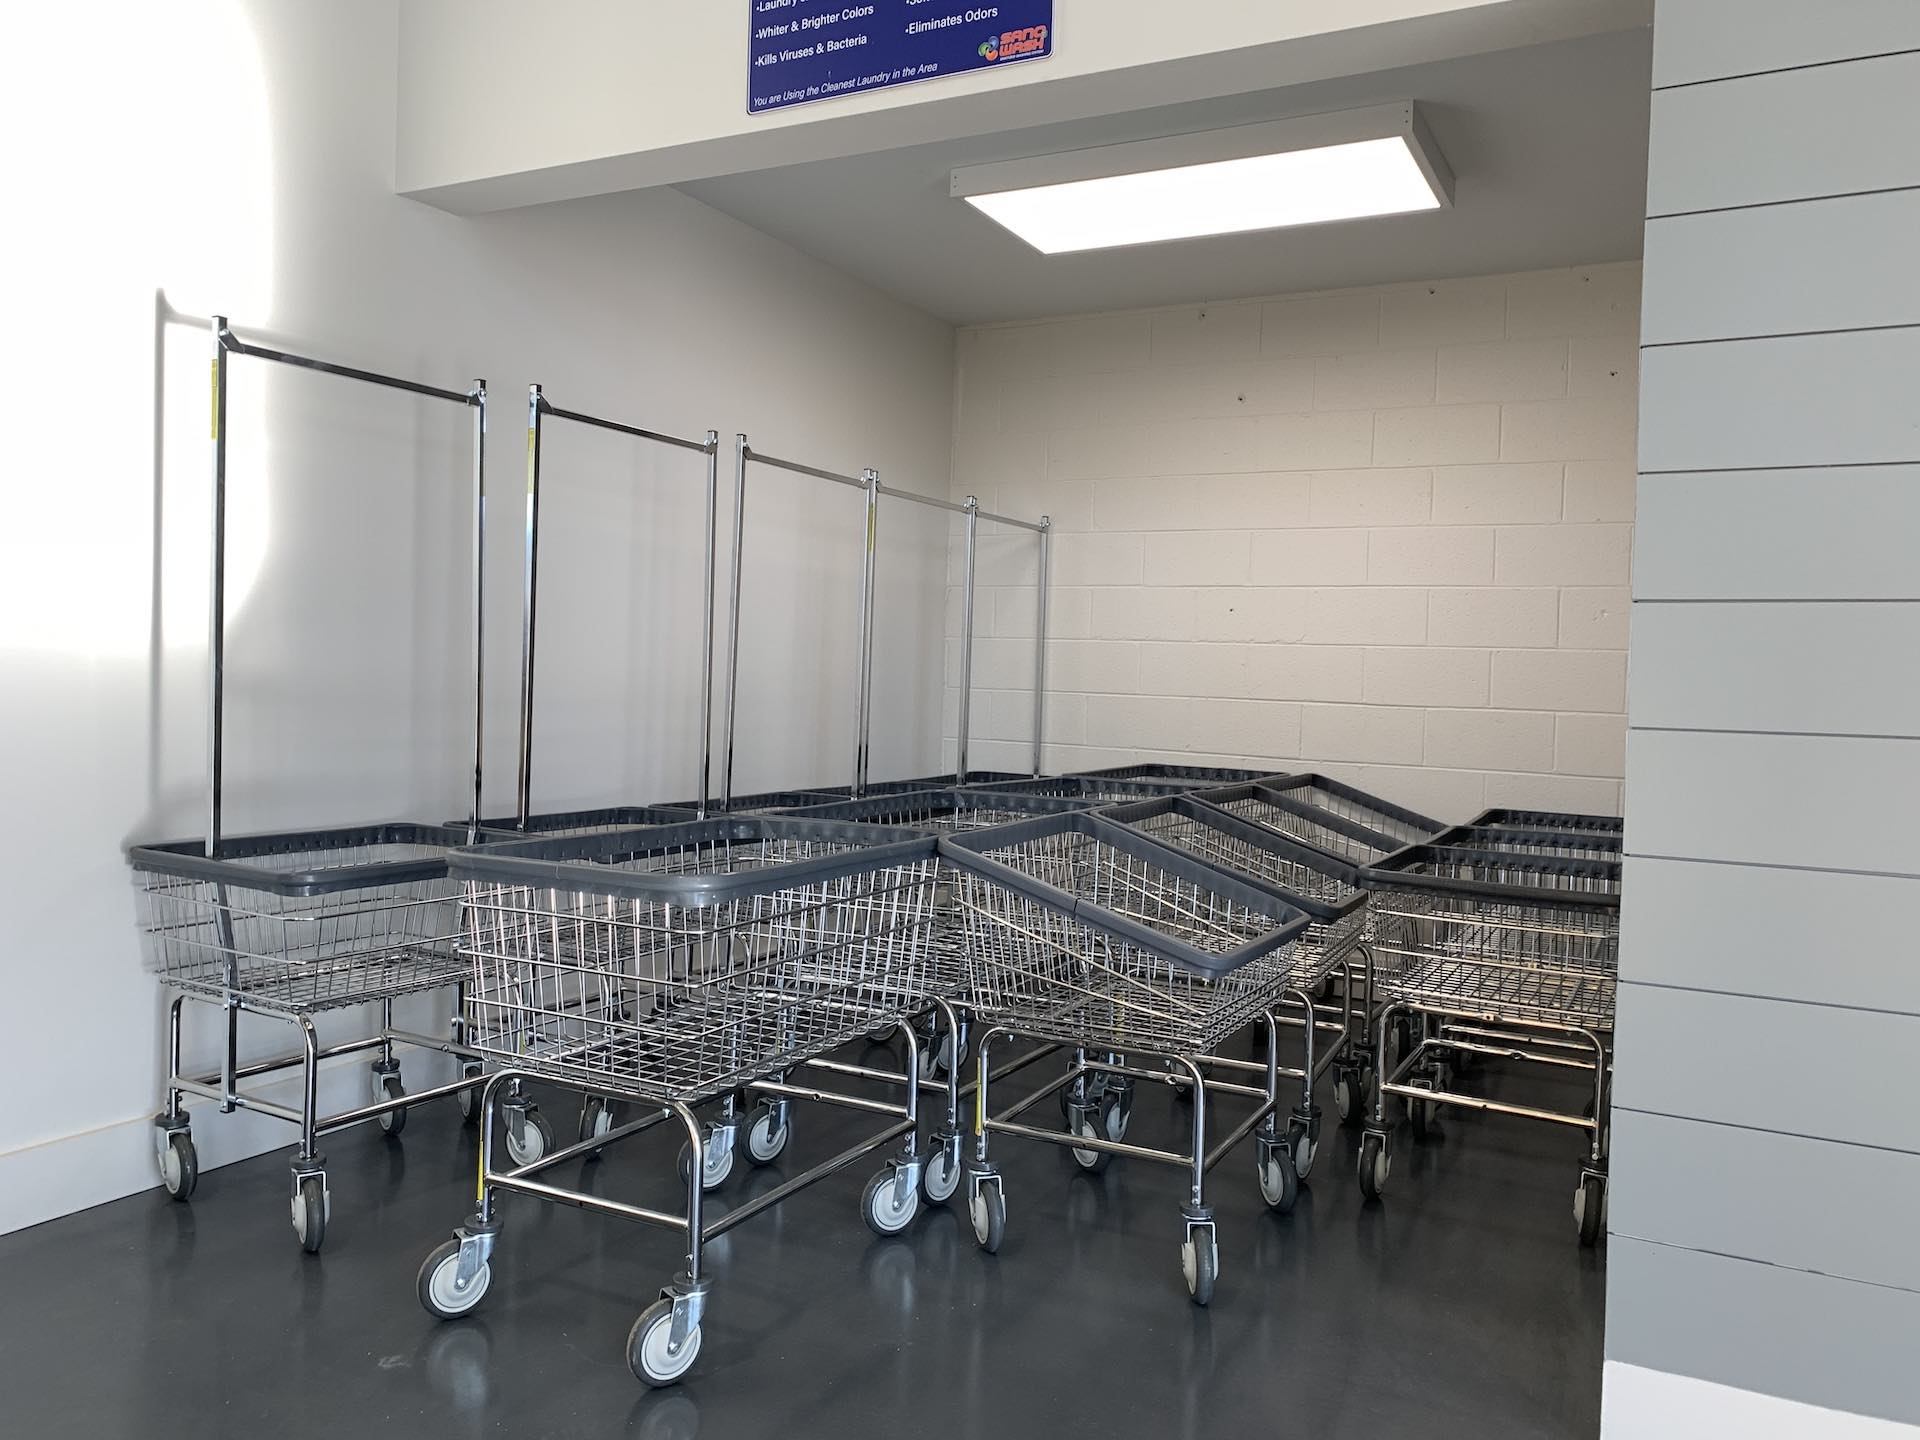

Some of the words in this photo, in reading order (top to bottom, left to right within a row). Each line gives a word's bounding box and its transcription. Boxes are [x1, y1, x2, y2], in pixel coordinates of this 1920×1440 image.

[791, 21, 799, 32] &
[801, 13, 840, 29] Brighter
[842, 5, 874, 20] Colors
[965, 7, 998, 22] Odors
[780, 46, 814, 61] Viruses
[816, 43, 825, 54] &
[827, 34, 867, 52] Bacteria
[753, 96, 767, 107] You
[768, 94, 781, 103] are
[783, 88, 805, 101] Using
[806, 84, 819, 96] the
[821, 77, 856, 94] Cleanest
[857, 71, 891, 86] Laundry
[892, 69, 901, 79] in
[902, 65, 916, 76] the
[918, 62, 938, 74] Area
